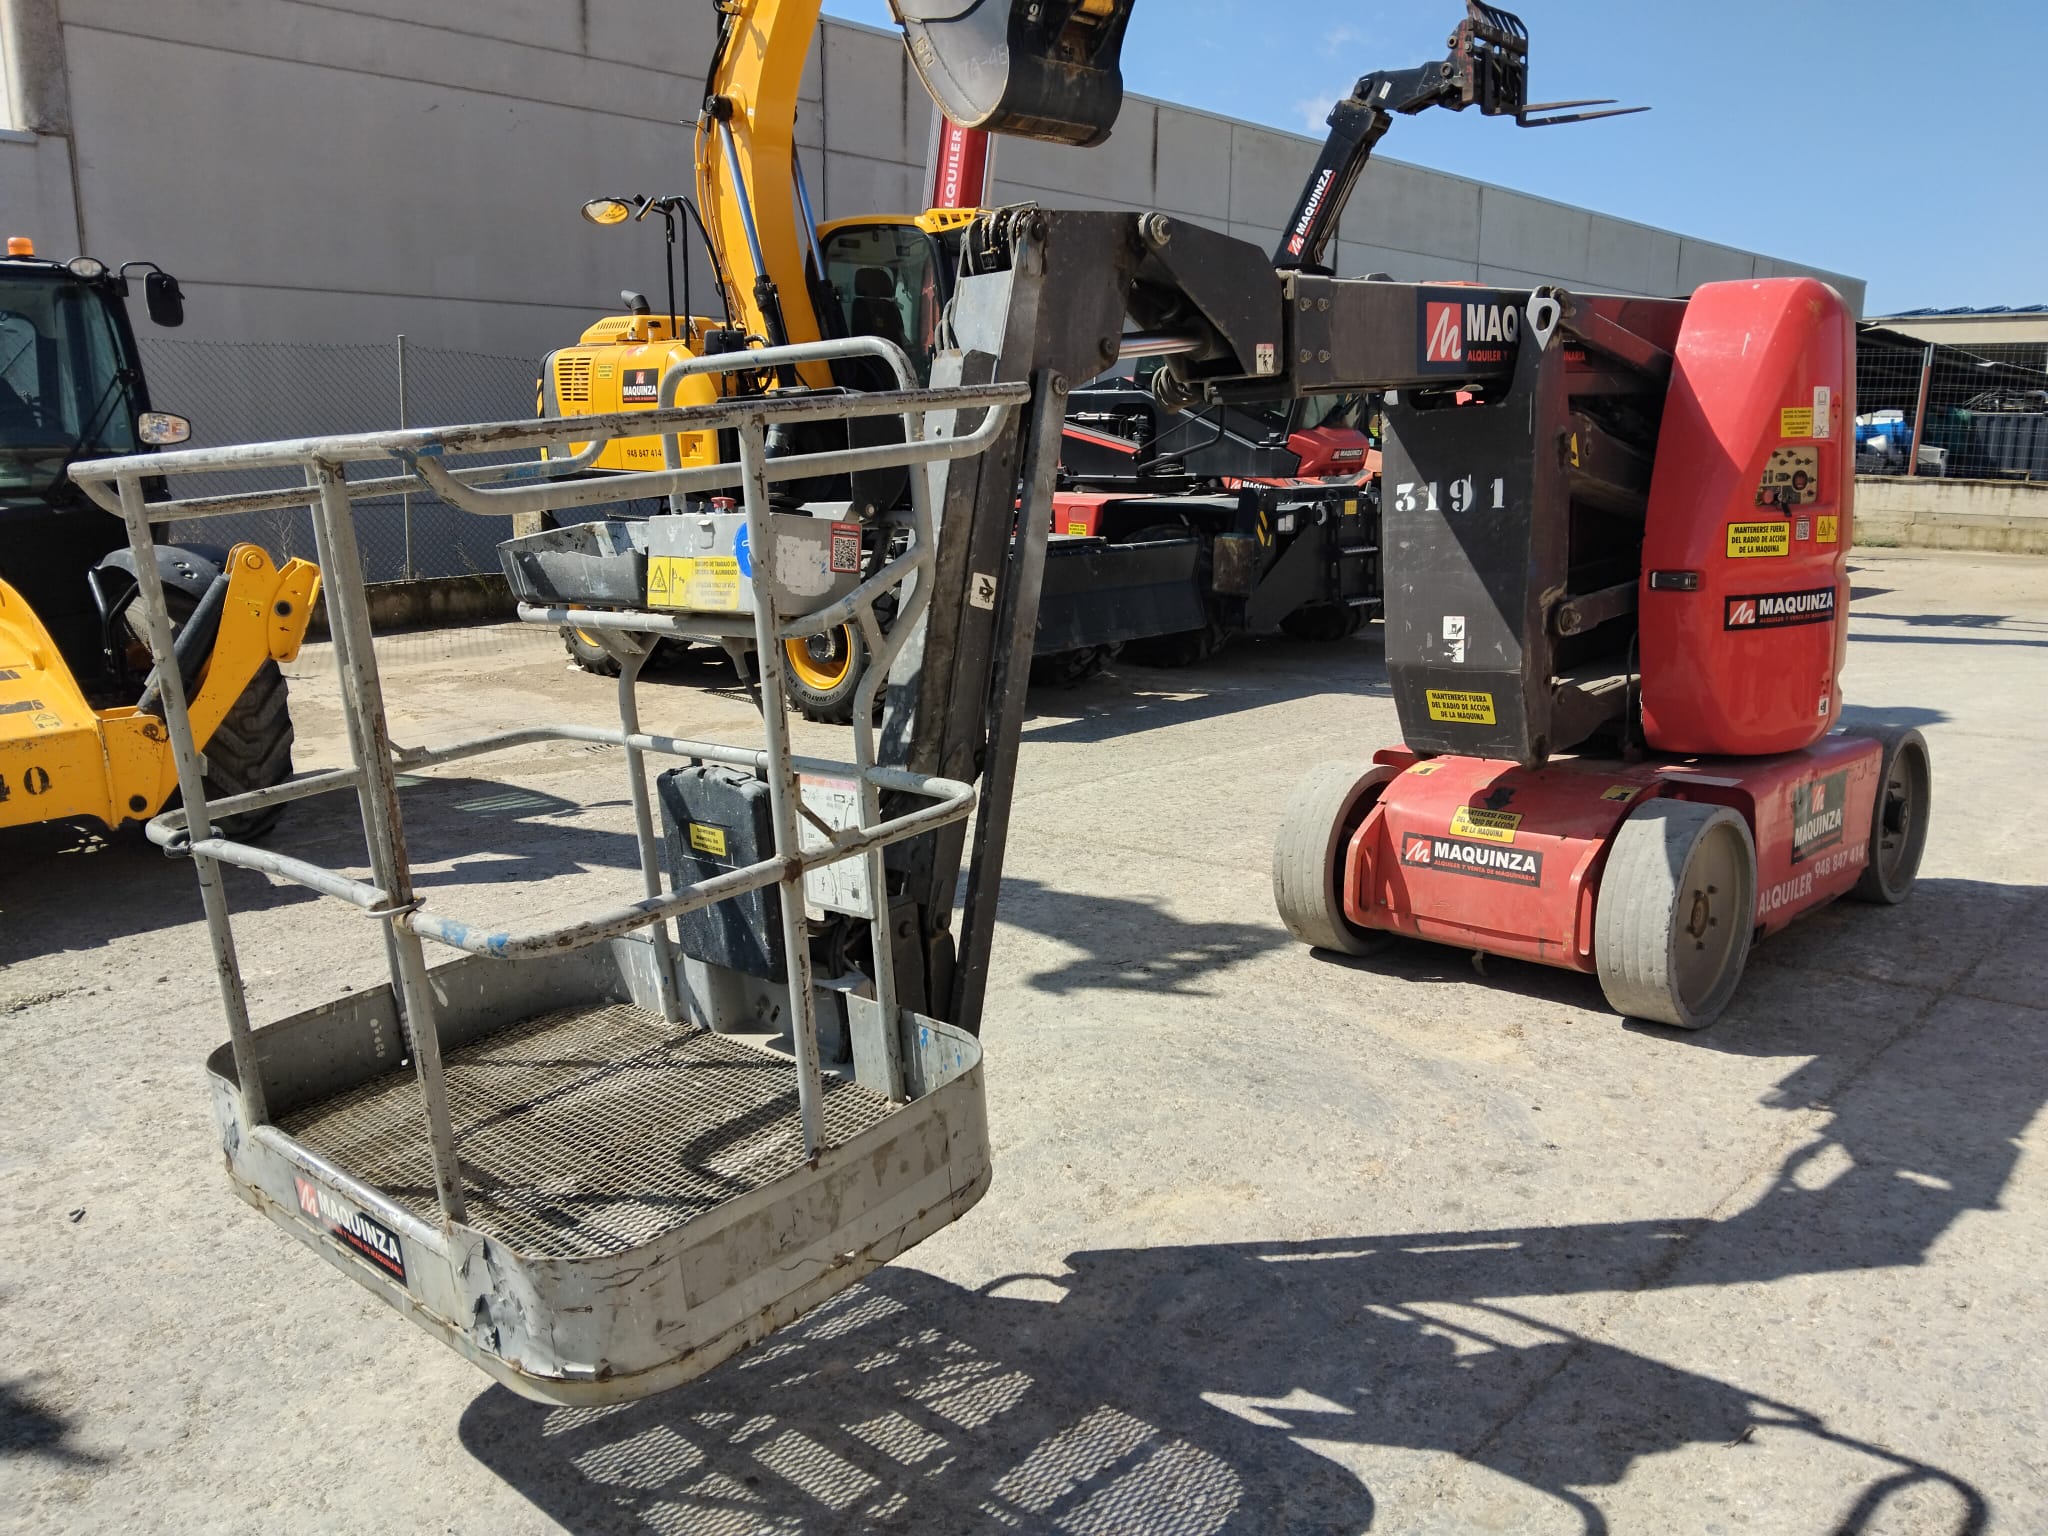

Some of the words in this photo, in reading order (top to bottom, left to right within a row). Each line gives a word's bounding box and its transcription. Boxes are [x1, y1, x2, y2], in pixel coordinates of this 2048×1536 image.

[944, 130, 963, 208] LQUILER
[1296, 169, 1333, 235] MAQUINZA
[1468, 350, 1501, 361] ALQUILER
[623, 386, 657, 396] MAQUINZA
[1395, 473, 1505, 512] 3191
[1731, 536, 1741, 544] DEL
[1762, 535, 1768, 543] DE
[1734, 526, 1769, 534] MANTENERSE
[1770, 525, 1785, 533] FUERA
[1759, 592, 1833, 615] MAQUINZA
[1432, 693, 1468, 702] MANTENERSE
[1469, 695, 1487, 703] FUERA
[1498, 812, 1517, 821] FUERA
[1795, 808, 1842, 847] MAQUINZA
[1434, 841, 1537, 873] MAQUINZA
[1434, 860, 1461, 869] ALQUILER
[1468, 865, 1486, 873] VENTA
[1495, 869, 1536, 882] MAQUINARIA
[1757, 872, 1812, 917] ALQUILER
[1815, 857, 1831, 878] 948
[1832, 850, 1848, 871] 847
[1850, 843, 1865, 863] 414
[317, 1190, 402, 1265] MAQUINZA
